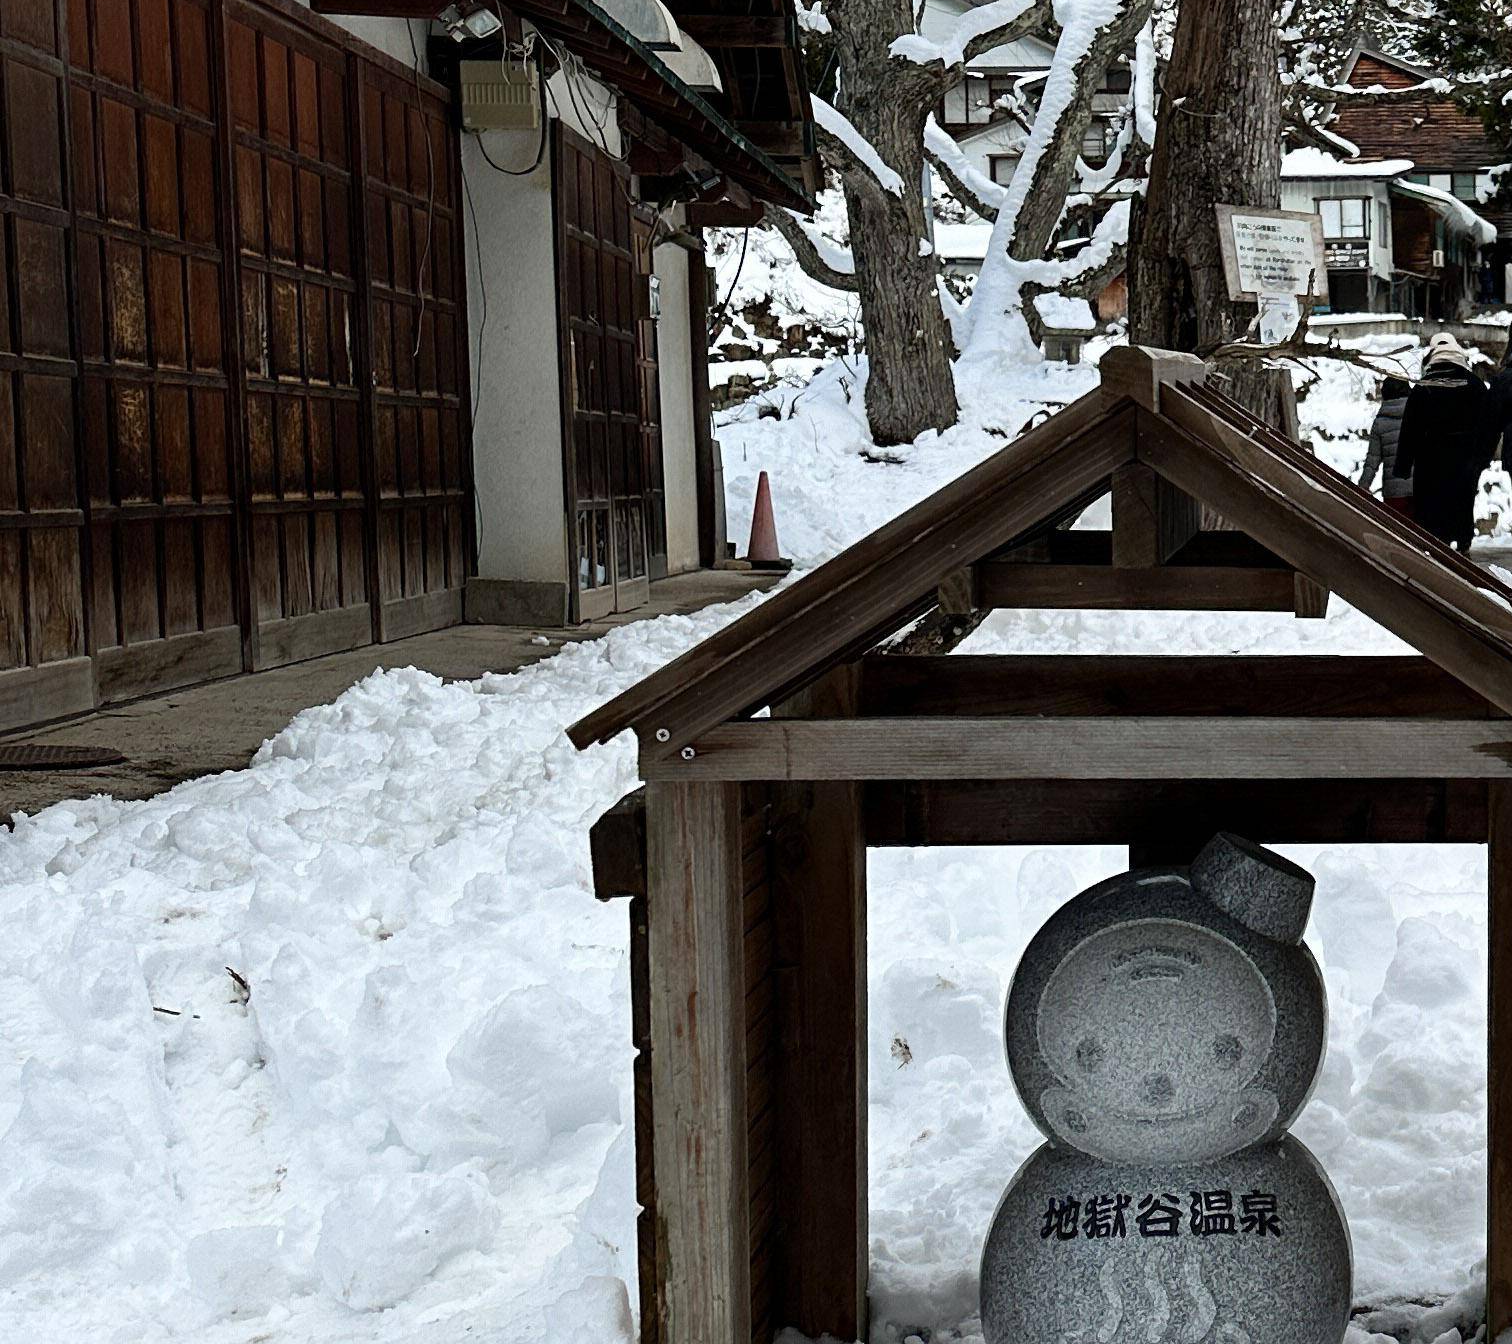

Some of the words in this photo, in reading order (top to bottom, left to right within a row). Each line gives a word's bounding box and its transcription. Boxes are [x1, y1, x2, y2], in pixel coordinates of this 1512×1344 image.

[1039, 1189, 1282, 1241] 地獄谷温泉
